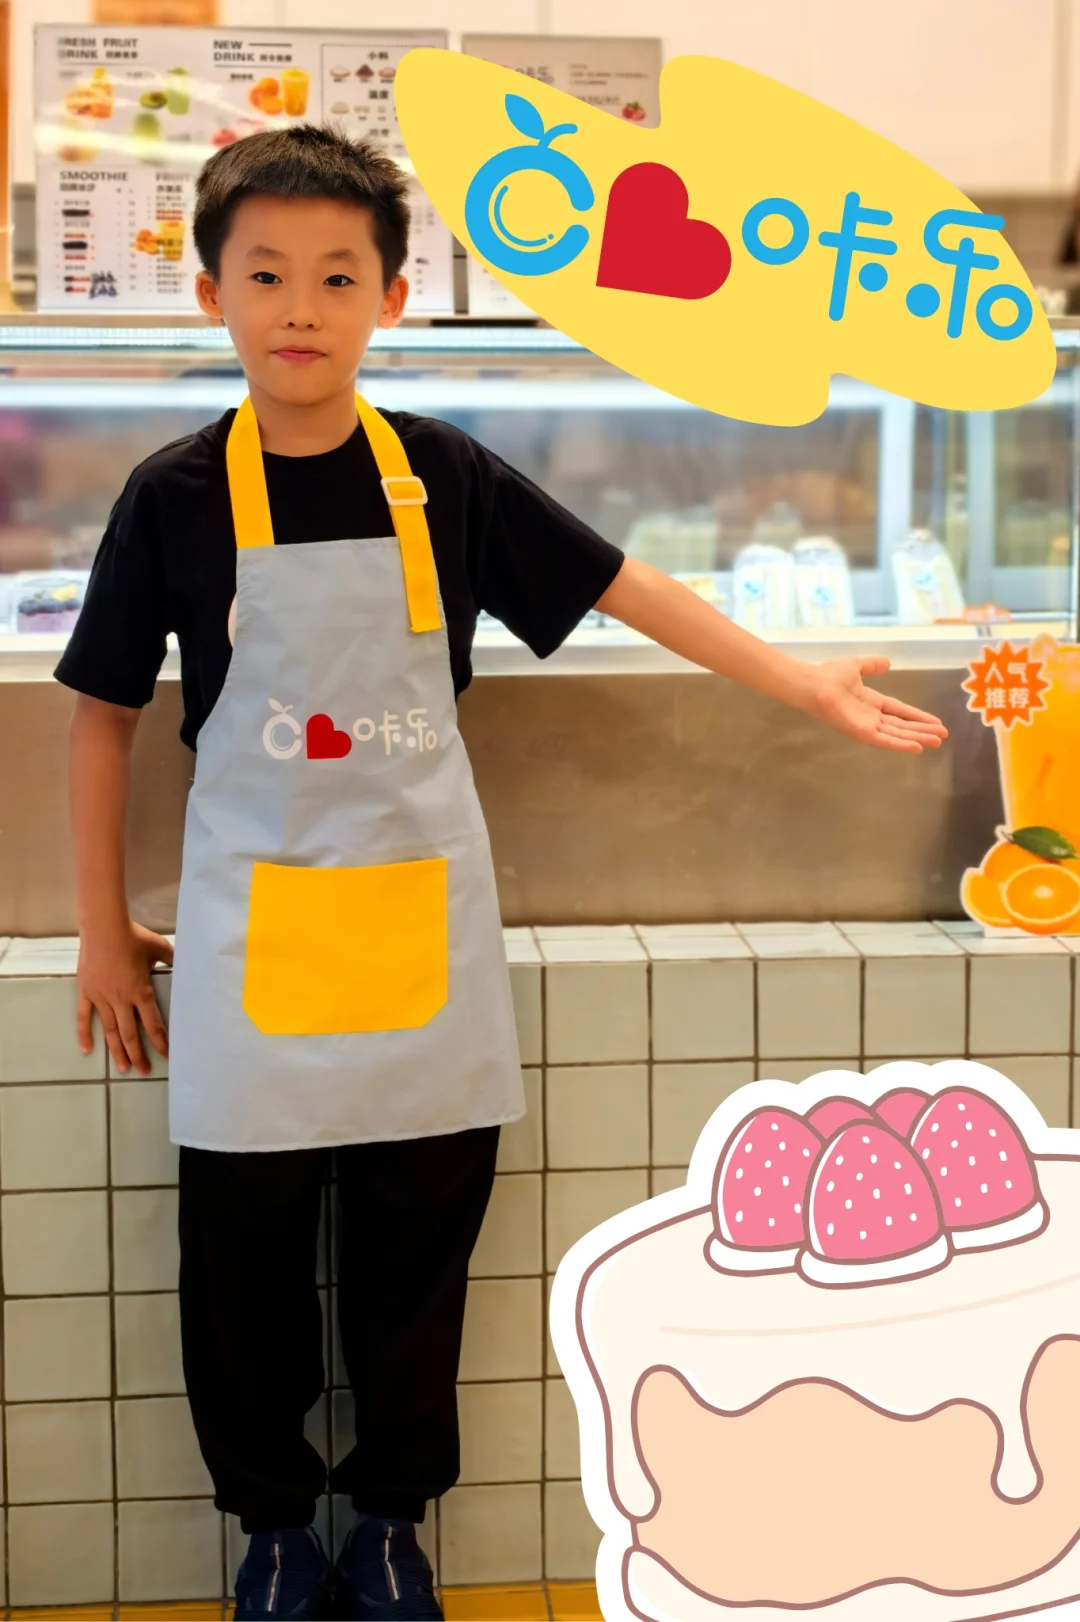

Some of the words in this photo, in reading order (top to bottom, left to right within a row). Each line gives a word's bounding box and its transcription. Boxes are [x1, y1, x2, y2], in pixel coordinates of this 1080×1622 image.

[213, 40, 243, 49] NEW
[213, 52, 255, 62] DRINK
[59, 171, 129, 182] SMOOTHIE
[984, 662, 1029, 684] 人气
[984, 687, 1030, 709] 推荐
